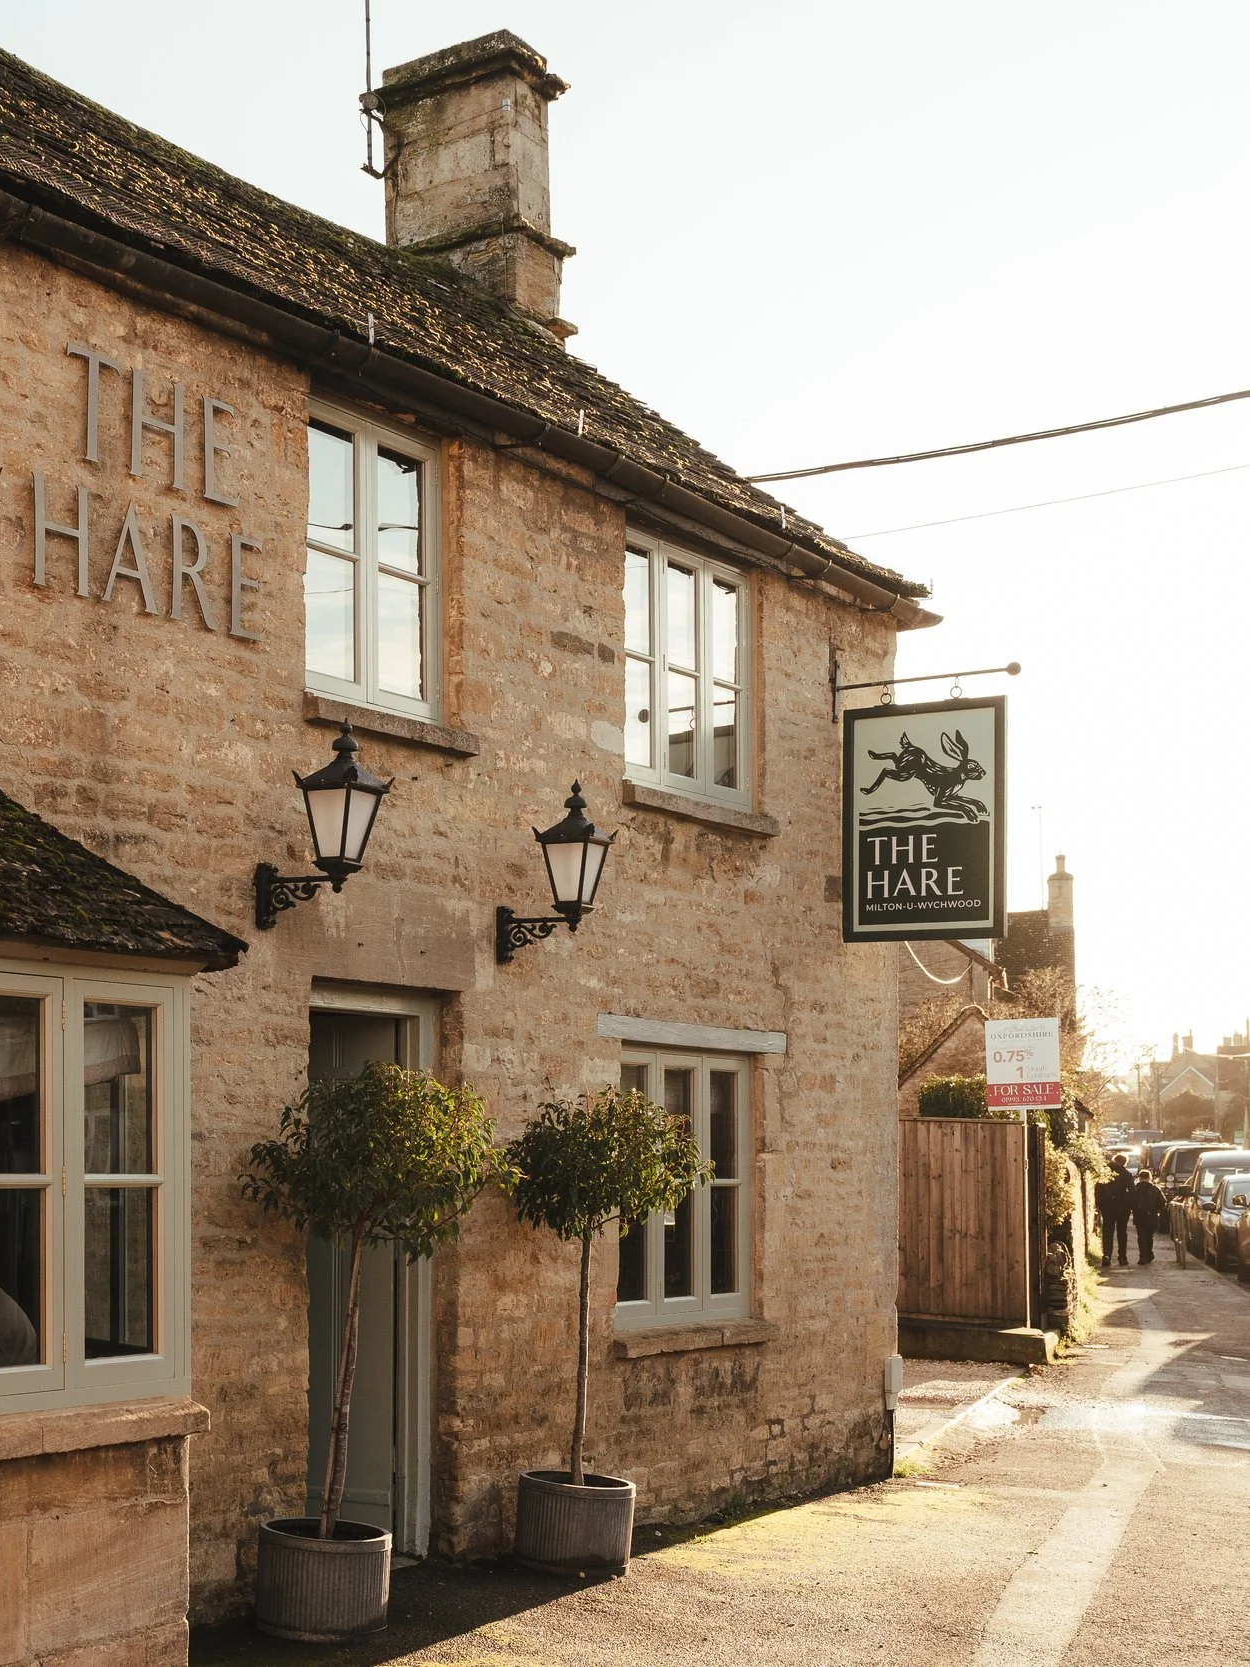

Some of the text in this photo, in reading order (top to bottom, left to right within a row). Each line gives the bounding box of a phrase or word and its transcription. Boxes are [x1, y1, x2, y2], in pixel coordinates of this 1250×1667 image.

[66, 342, 240, 507] THE
[31, 470, 265, 641] HARE
[866, 833, 938, 865] THE
[866, 866, 964, 899] HARE
[866, 899, 981, 912] MILTON-U-WYCHWOOD
[990, 1031, 1054, 1040] OXFORDSHIRE
[993, 1049, 1033, 1063] 0.75%
[1016, 1066, 1023, 1079] 1
[994, 1084, 1054, 1096] FOR SALE
